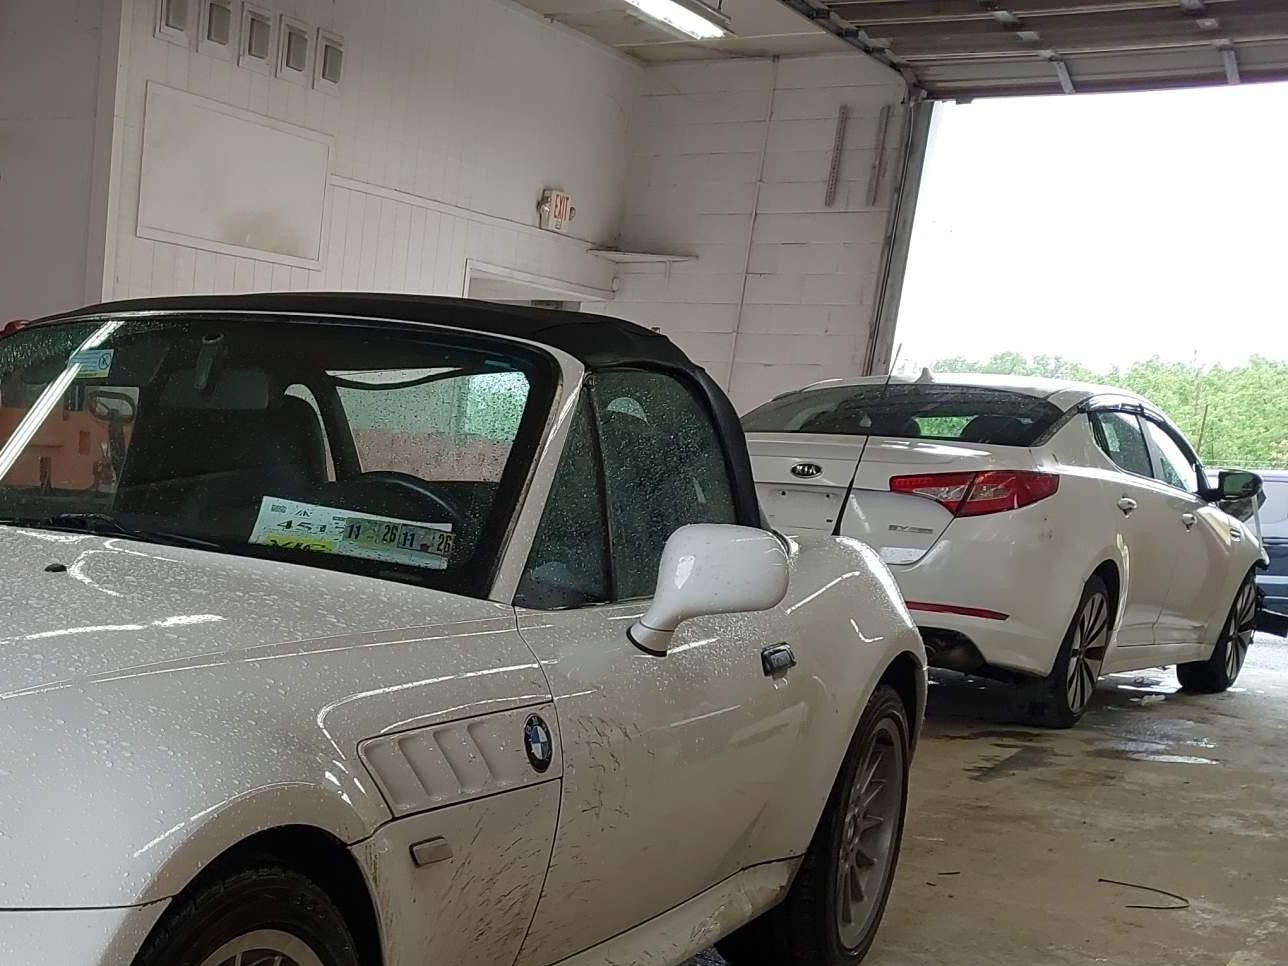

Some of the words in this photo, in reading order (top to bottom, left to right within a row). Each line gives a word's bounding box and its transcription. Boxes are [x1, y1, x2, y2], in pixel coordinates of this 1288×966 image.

[554, 193, 569, 222] EXIT
[795, 465, 817, 475] KIA
[383, 525, 399, 543] 26
[436, 533, 452, 553] 26
